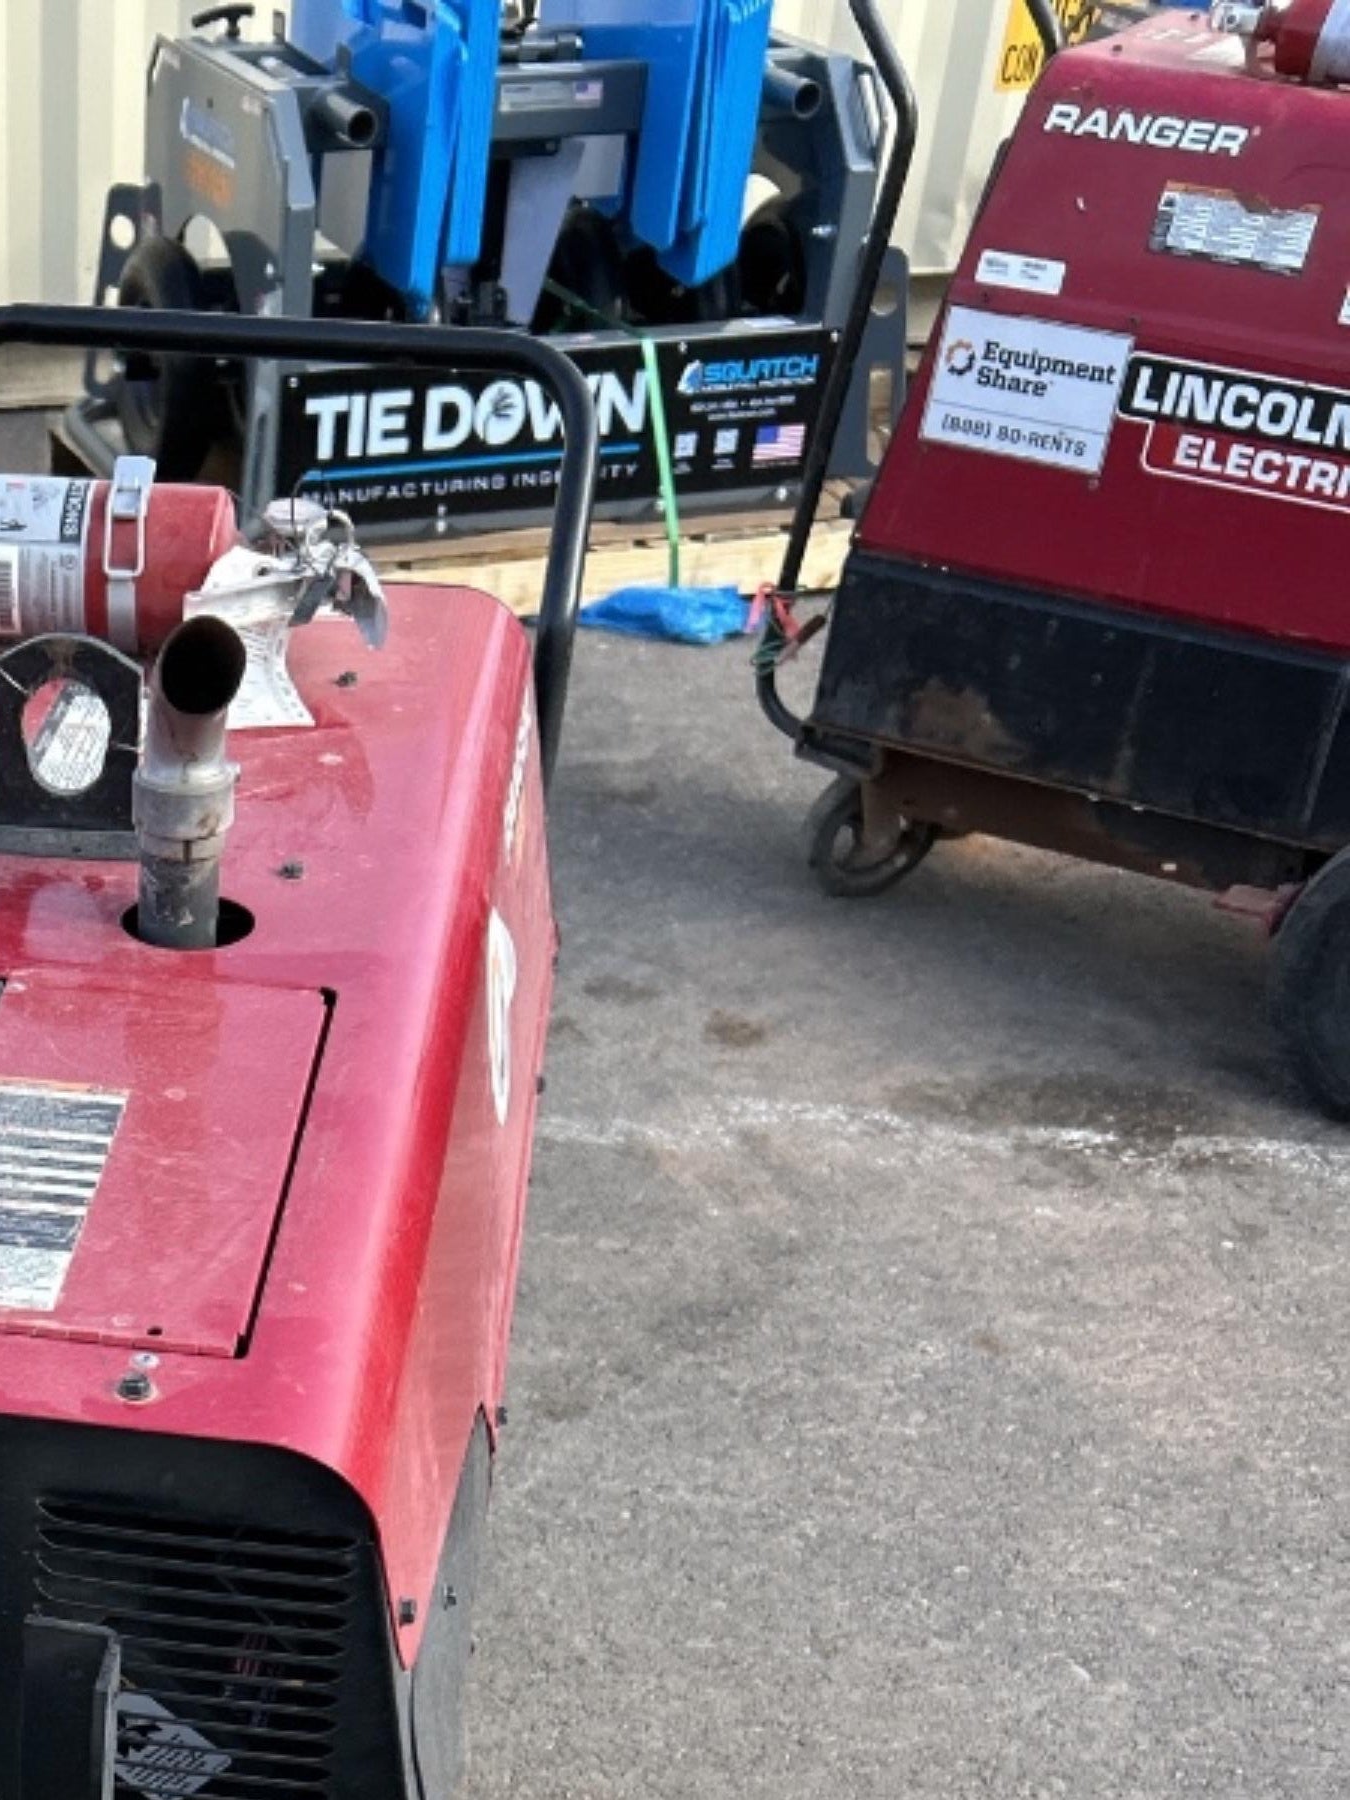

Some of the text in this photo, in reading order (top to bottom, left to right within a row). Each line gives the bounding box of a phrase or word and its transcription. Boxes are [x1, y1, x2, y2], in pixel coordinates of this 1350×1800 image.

[1043, 103, 1249, 157] RANGER
[701, 354, 819, 383] SQUATCH
[976, 365, 1048, 397] Share
[981, 341, 1117, 385] Equipment
[305, 369, 648, 460] TIE DOWN
[1131, 365, 1350, 451] LINCOLN
